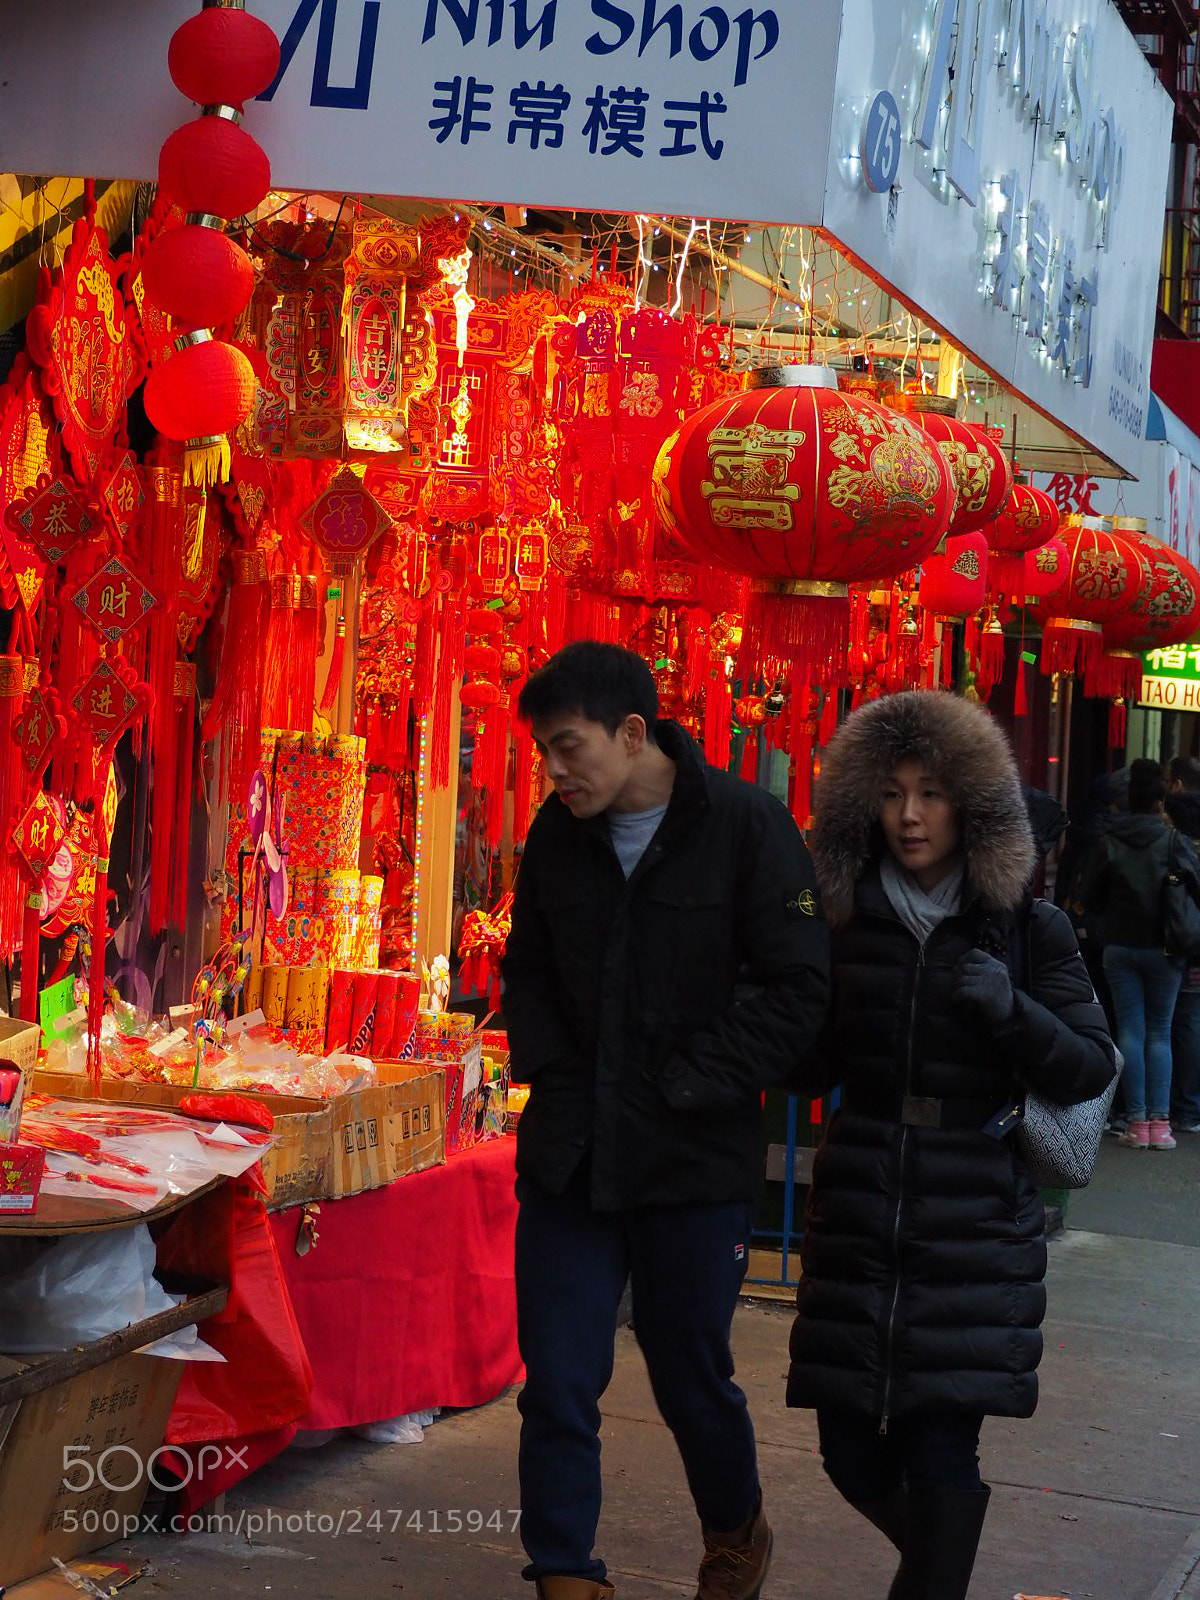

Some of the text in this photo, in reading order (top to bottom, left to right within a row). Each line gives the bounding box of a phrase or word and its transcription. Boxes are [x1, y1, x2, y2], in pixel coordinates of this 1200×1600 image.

[422, 0, 779, 87] Niu Shop
[428, 75, 727, 161] 非常模式
[871, 100, 897, 179] 75
[307, 308, 330, 375] 平安
[361, 312, 389, 380] 吉祥
[620, 370, 663, 418] 福
[116, 476, 135, 513] 招
[41, 500, 76, 538] 恭
[320, 493, 368, 547] 福
[520, 544, 541, 563] 福
[1036, 547, 1058, 573] 福
[99, 581, 131, 618] 财
[90, 683, 117, 718] 进
[1145, 680, 1200, 708] TAO H
[27, 709, 42, 746] 发
[30, 815, 50, 852] 财
